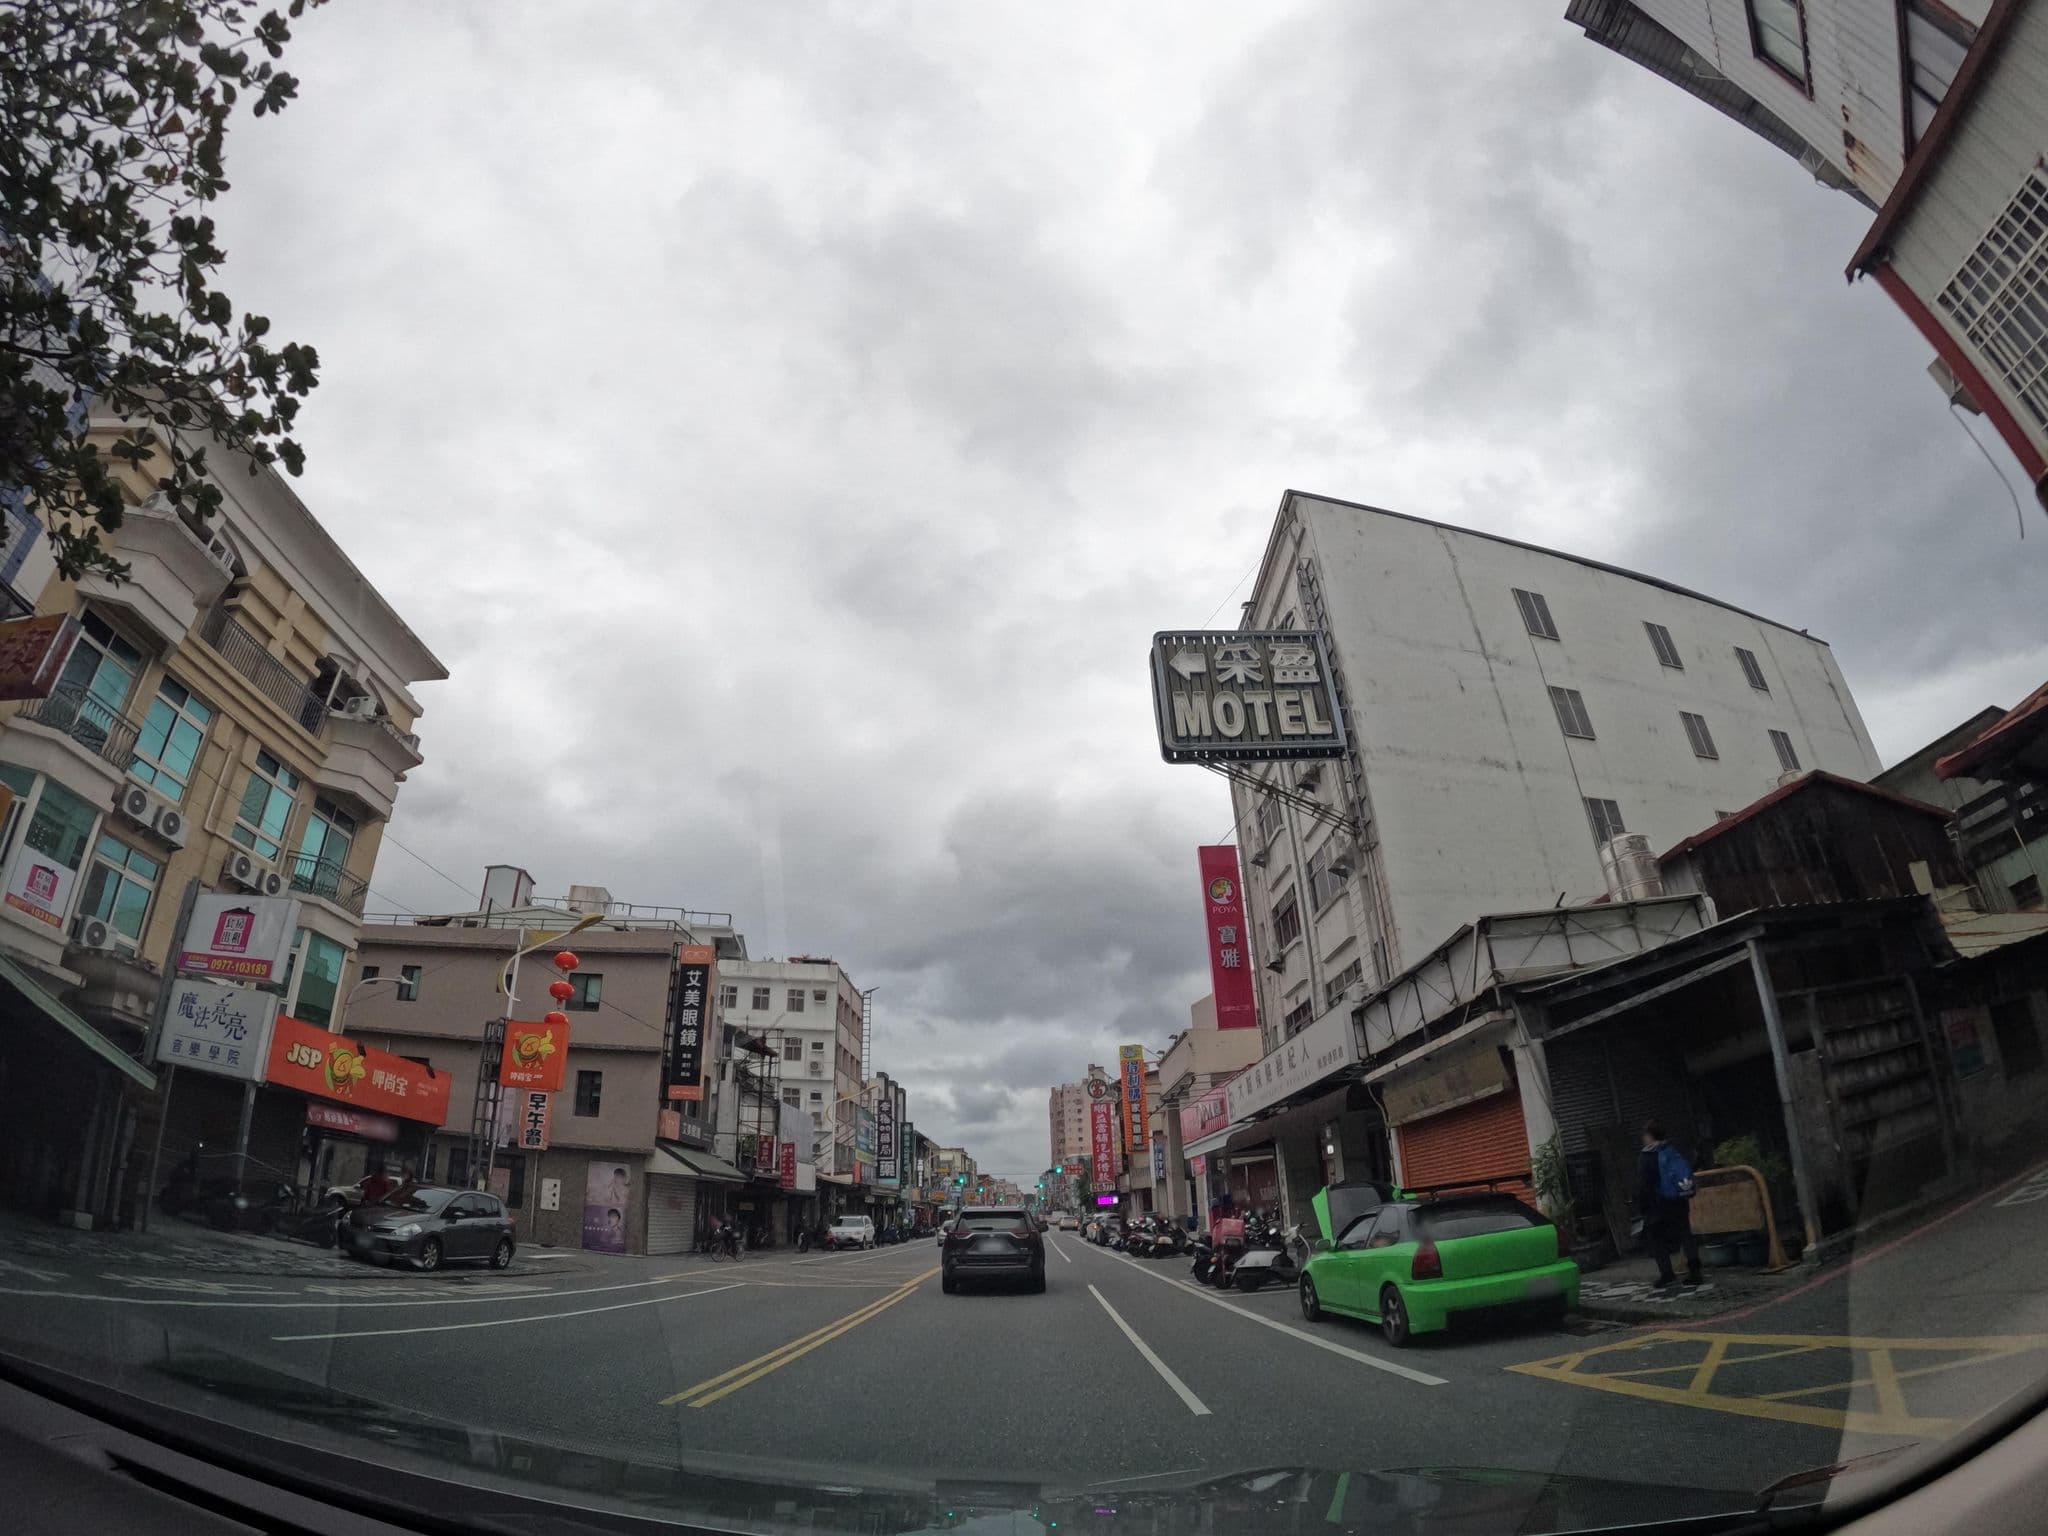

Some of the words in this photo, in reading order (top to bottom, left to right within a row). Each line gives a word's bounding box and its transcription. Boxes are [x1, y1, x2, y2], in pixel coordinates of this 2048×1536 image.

[1172, 690, 1333, 737] MOTEL
[1213, 905, 1238, 914] POYA
[210, 958, 268, 975] 0977-103189
[1217, 926, 1240, 968] 寶雅
[177, 991, 247, 1041] 魔法亮亮
[679, 969, 702, 1048] 艾美眼鏡
[171, 1038, 241, 1066] 音樂學院
[286, 1041, 323, 1069] JSP
[525, 1093, 548, 1147] 早午餐
